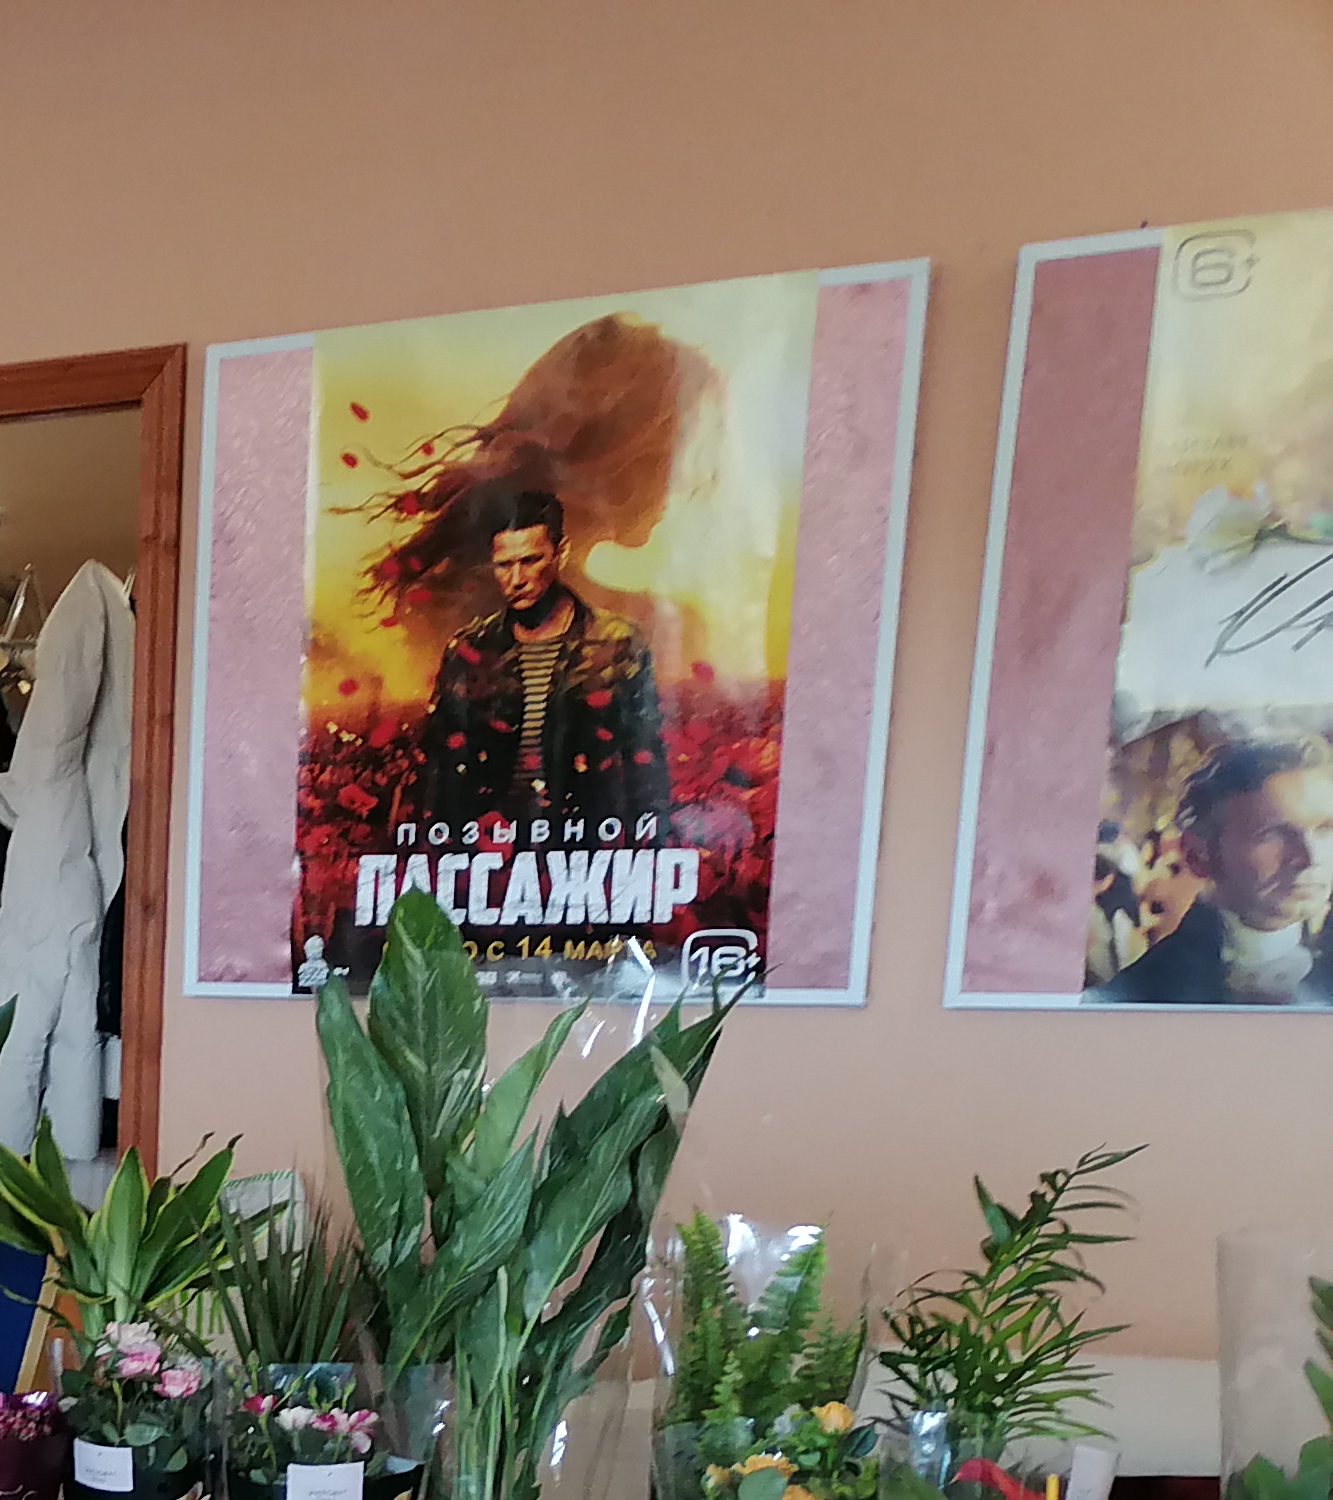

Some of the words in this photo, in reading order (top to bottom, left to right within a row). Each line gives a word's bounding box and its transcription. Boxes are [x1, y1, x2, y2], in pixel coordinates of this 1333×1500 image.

[397, 812, 657, 846] ПОЗЫВНОЙ
[354, 848, 700, 927] ПАССАЖИР
[486, 940, 505, 961] С
[516, 935, 554, 960] 14
